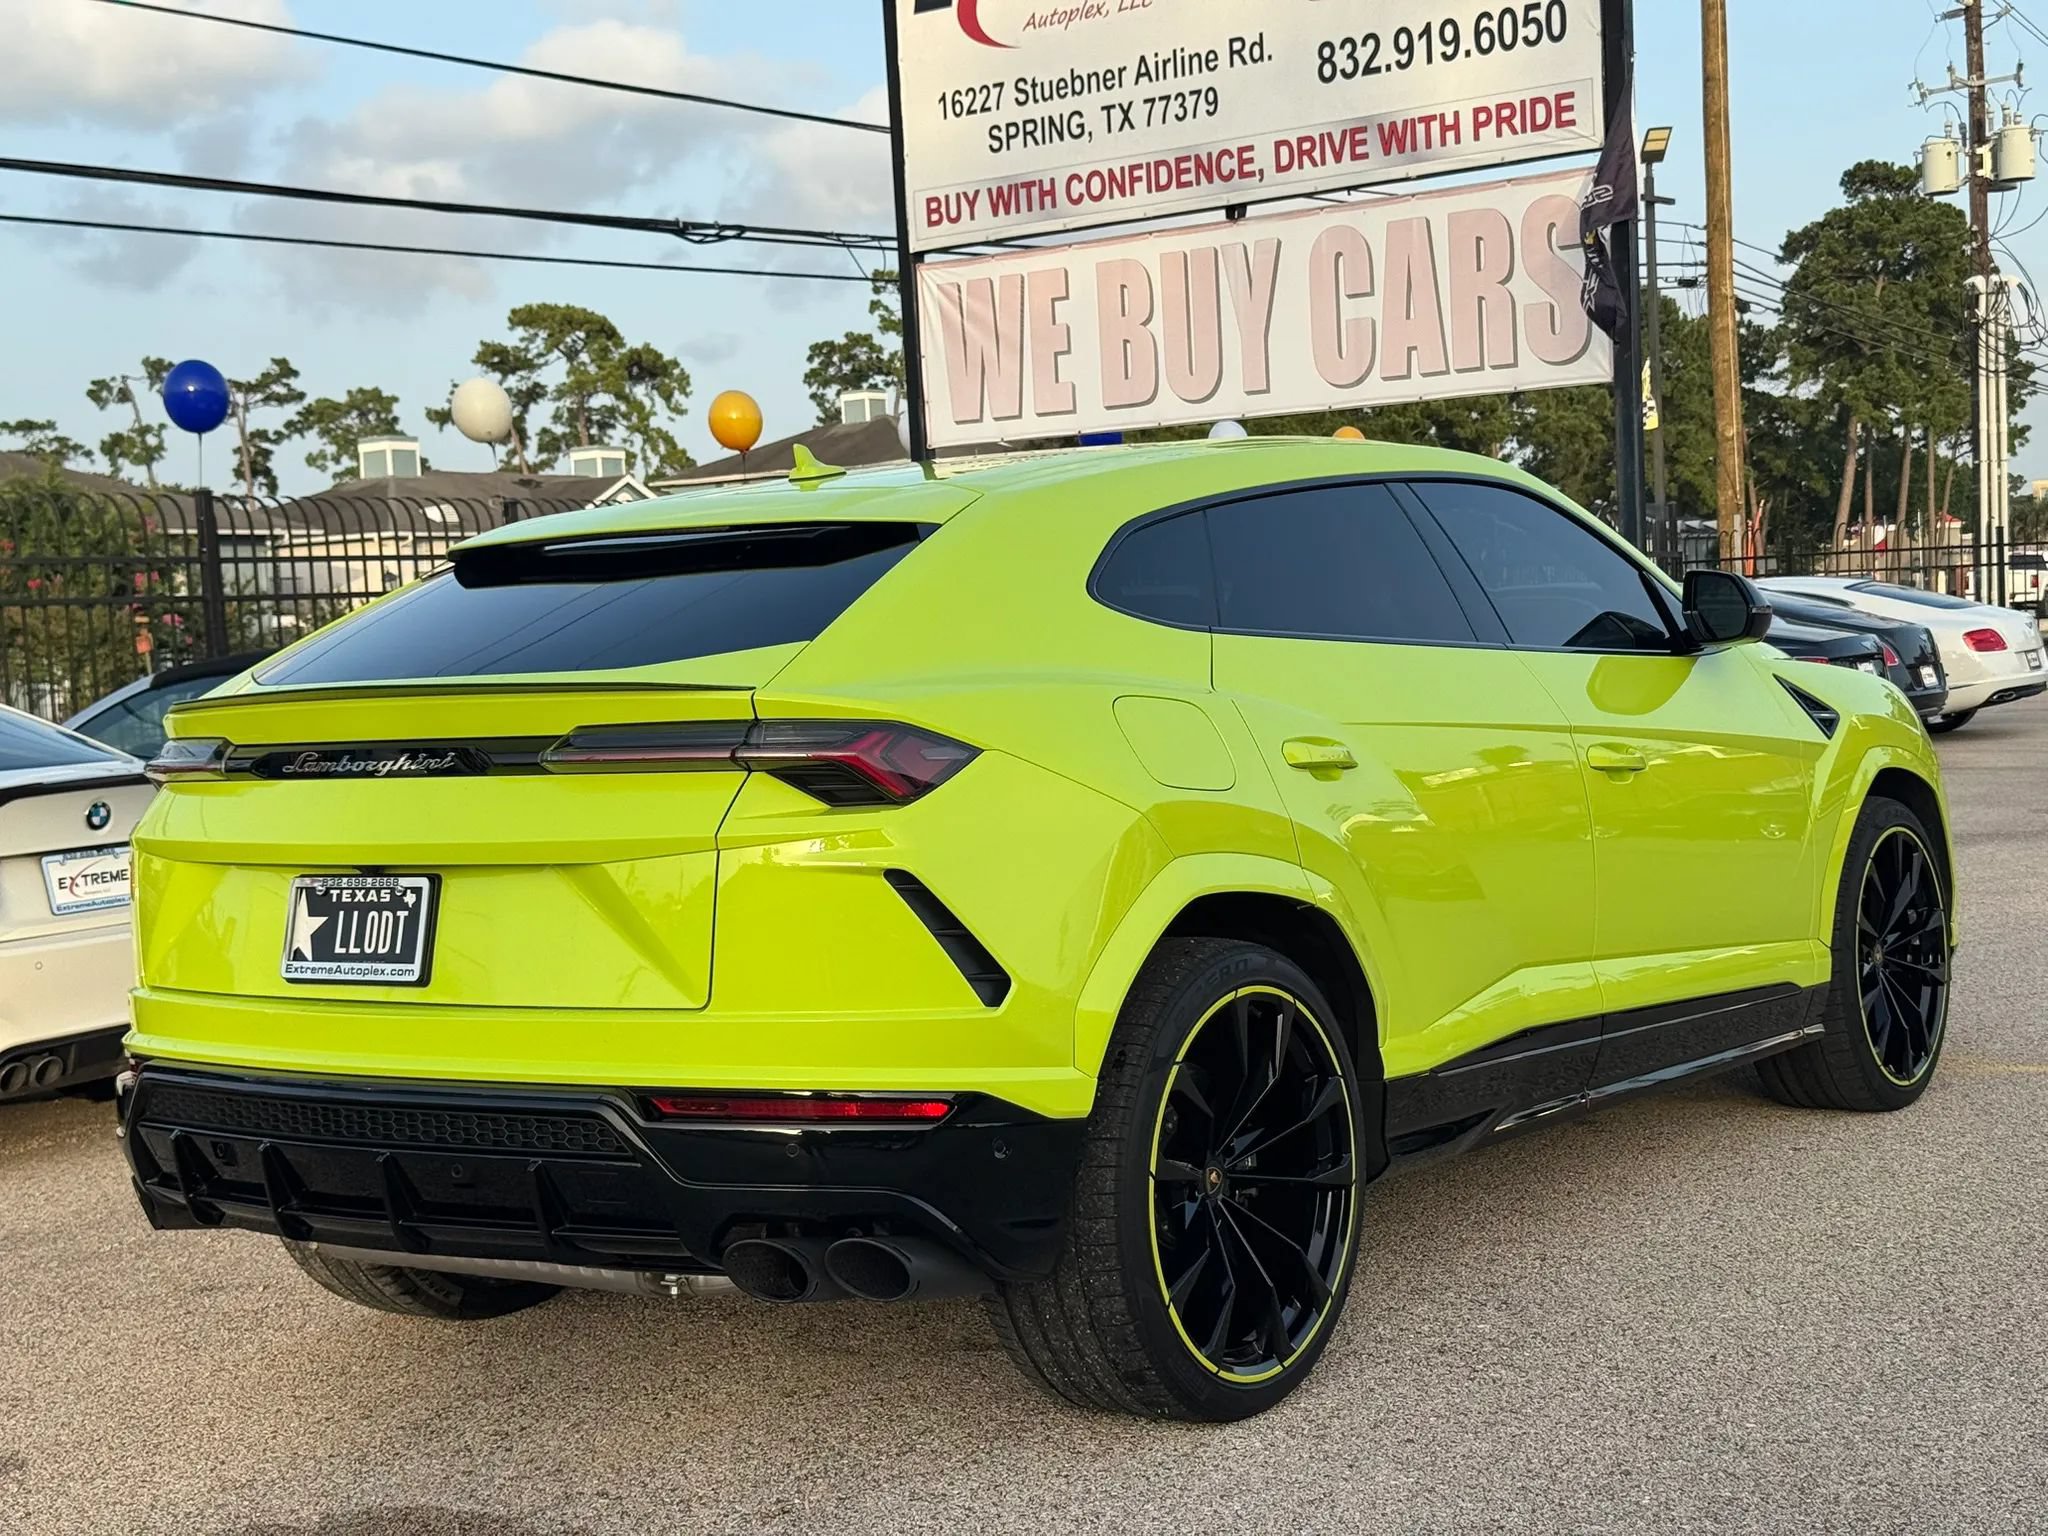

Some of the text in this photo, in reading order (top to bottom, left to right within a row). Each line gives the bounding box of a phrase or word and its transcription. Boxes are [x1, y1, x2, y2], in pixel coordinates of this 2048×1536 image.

[1023, 0, 1109, 31] Autoplex,
[1317, 1, 1568, 84] 832.919.6050
[938, 32, 1273, 120] 16227 Stuebner Airline Rd.
[988, 86, 1219, 154] SPRING, TX 77379
[926, 91, 1577, 228] BUY WITH CONFIDENCE, DRIVE WITH PRIDE
[938, 267, 1077, 425] WE
[1095, 237, 1282, 411] BUY
[1310, 195, 1591, 388] CARS
[282, 751, 456, 777] Lamborghini
[58, 869, 129, 890] EXTREME
[321, 878, 399, 888] 832-698-2668
[330, 889, 391, 903] TEXAS
[285, 963, 415, 978] ExtremeAutoplex.com
